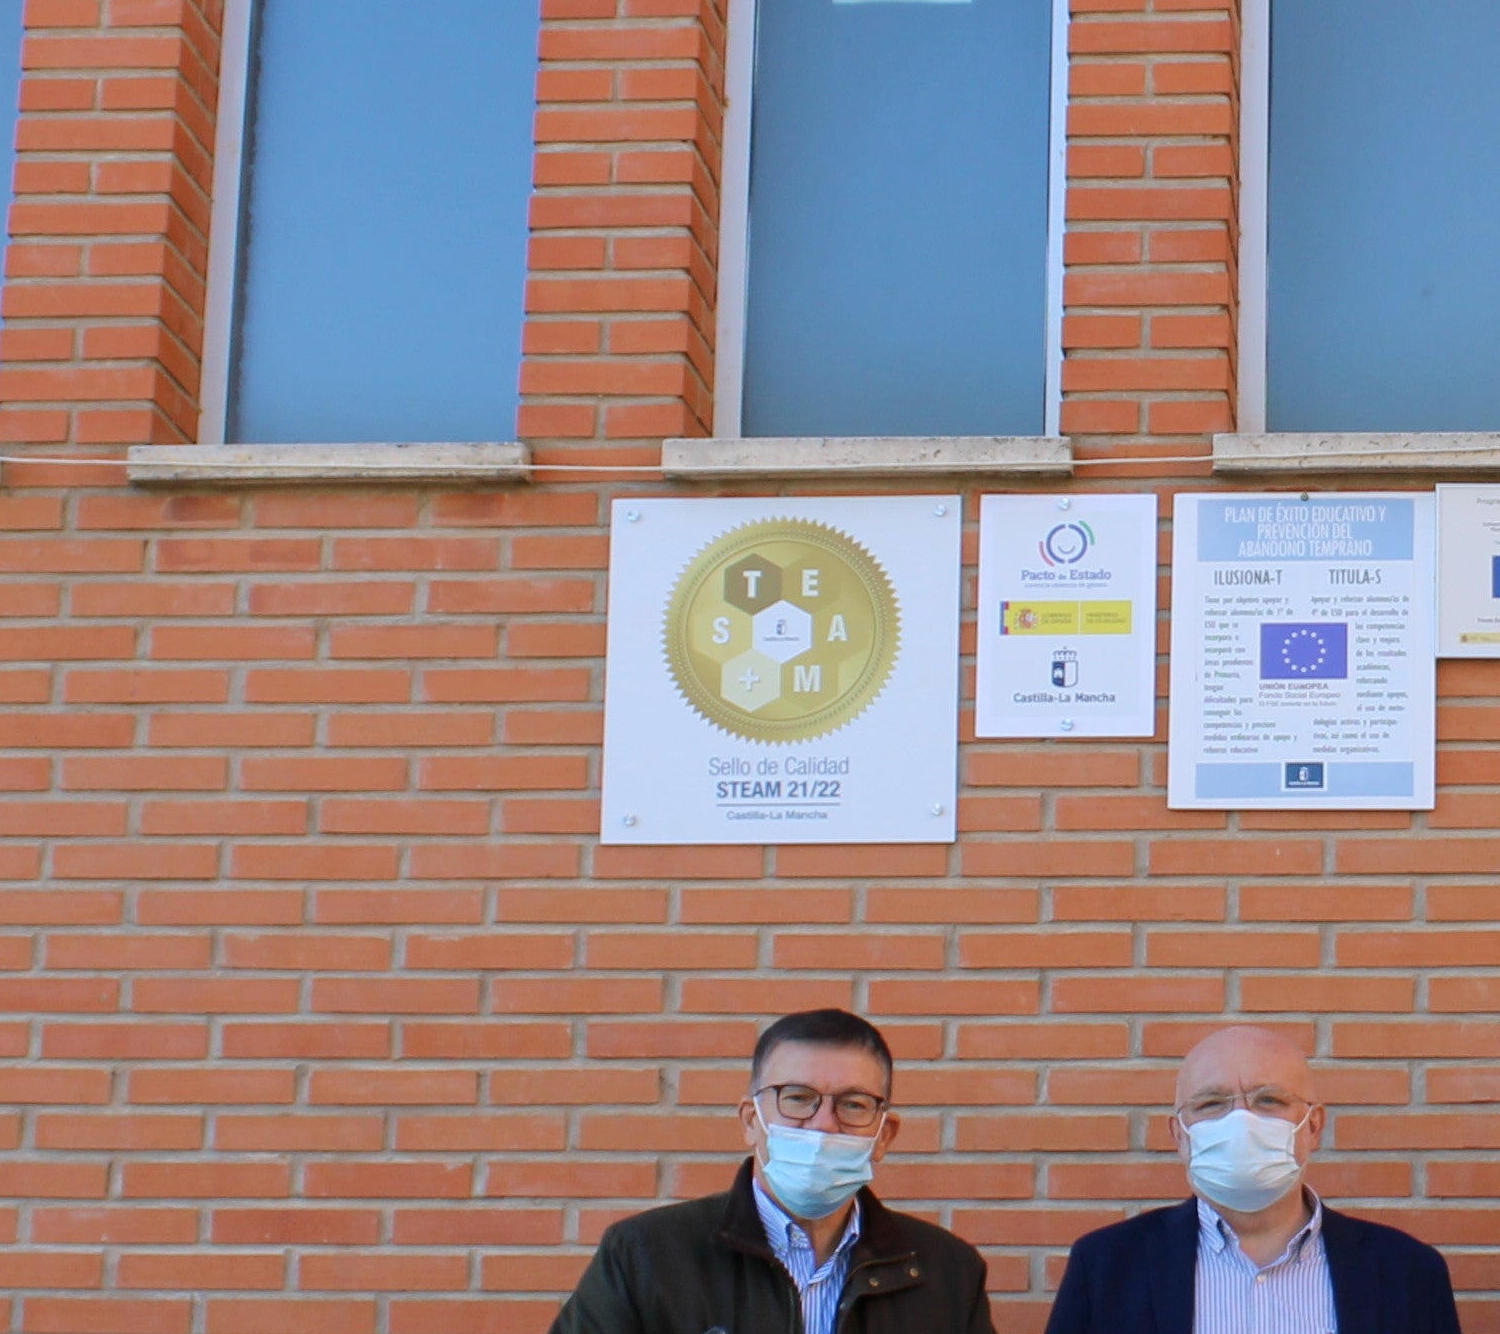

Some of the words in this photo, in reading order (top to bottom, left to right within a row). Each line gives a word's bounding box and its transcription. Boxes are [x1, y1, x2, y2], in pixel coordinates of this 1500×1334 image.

[1225, 506, 1255, 522] PLAN
[1259, 506, 1273, 522] DE
[1276, 502, 1307, 522] ÉXITO
[1312, 506, 1376, 521] EDUCATIVO
[1378, 506, 1386, 521] Y
[1258, 522, 1329, 539] PREVENCIÓN
[1333, 525, 1352, 538] DEL
[1239, 541, 1305, 556] ABANDONO
[1310, 541, 1372, 556] TEMPRANO
[1022, 569, 1054, 581] Pacto
[1070, 569, 1111, 581] Estado
[1214, 570, 1282, 585] ILUSIONA-T
[1329, 569, 1381, 584] TITULA-S
[1014, 693, 1071, 702] Castilla-La
[1076, 693, 1115, 702] Mancha
[1259, 691, 1279, 700] Fondo
[1282, 691, 1306, 700] Social
[1309, 691, 1340, 700] Europeo
[709, 757, 750, 775] Sello
[758, 757, 779, 775] de
[785, 757, 849, 775] Calidad
[717, 782, 781, 798] STEAM
[788, 780, 840, 799] 21/22
[727, 811, 782, 820] Castilla-La
[786, 811, 827, 820] Mancha
